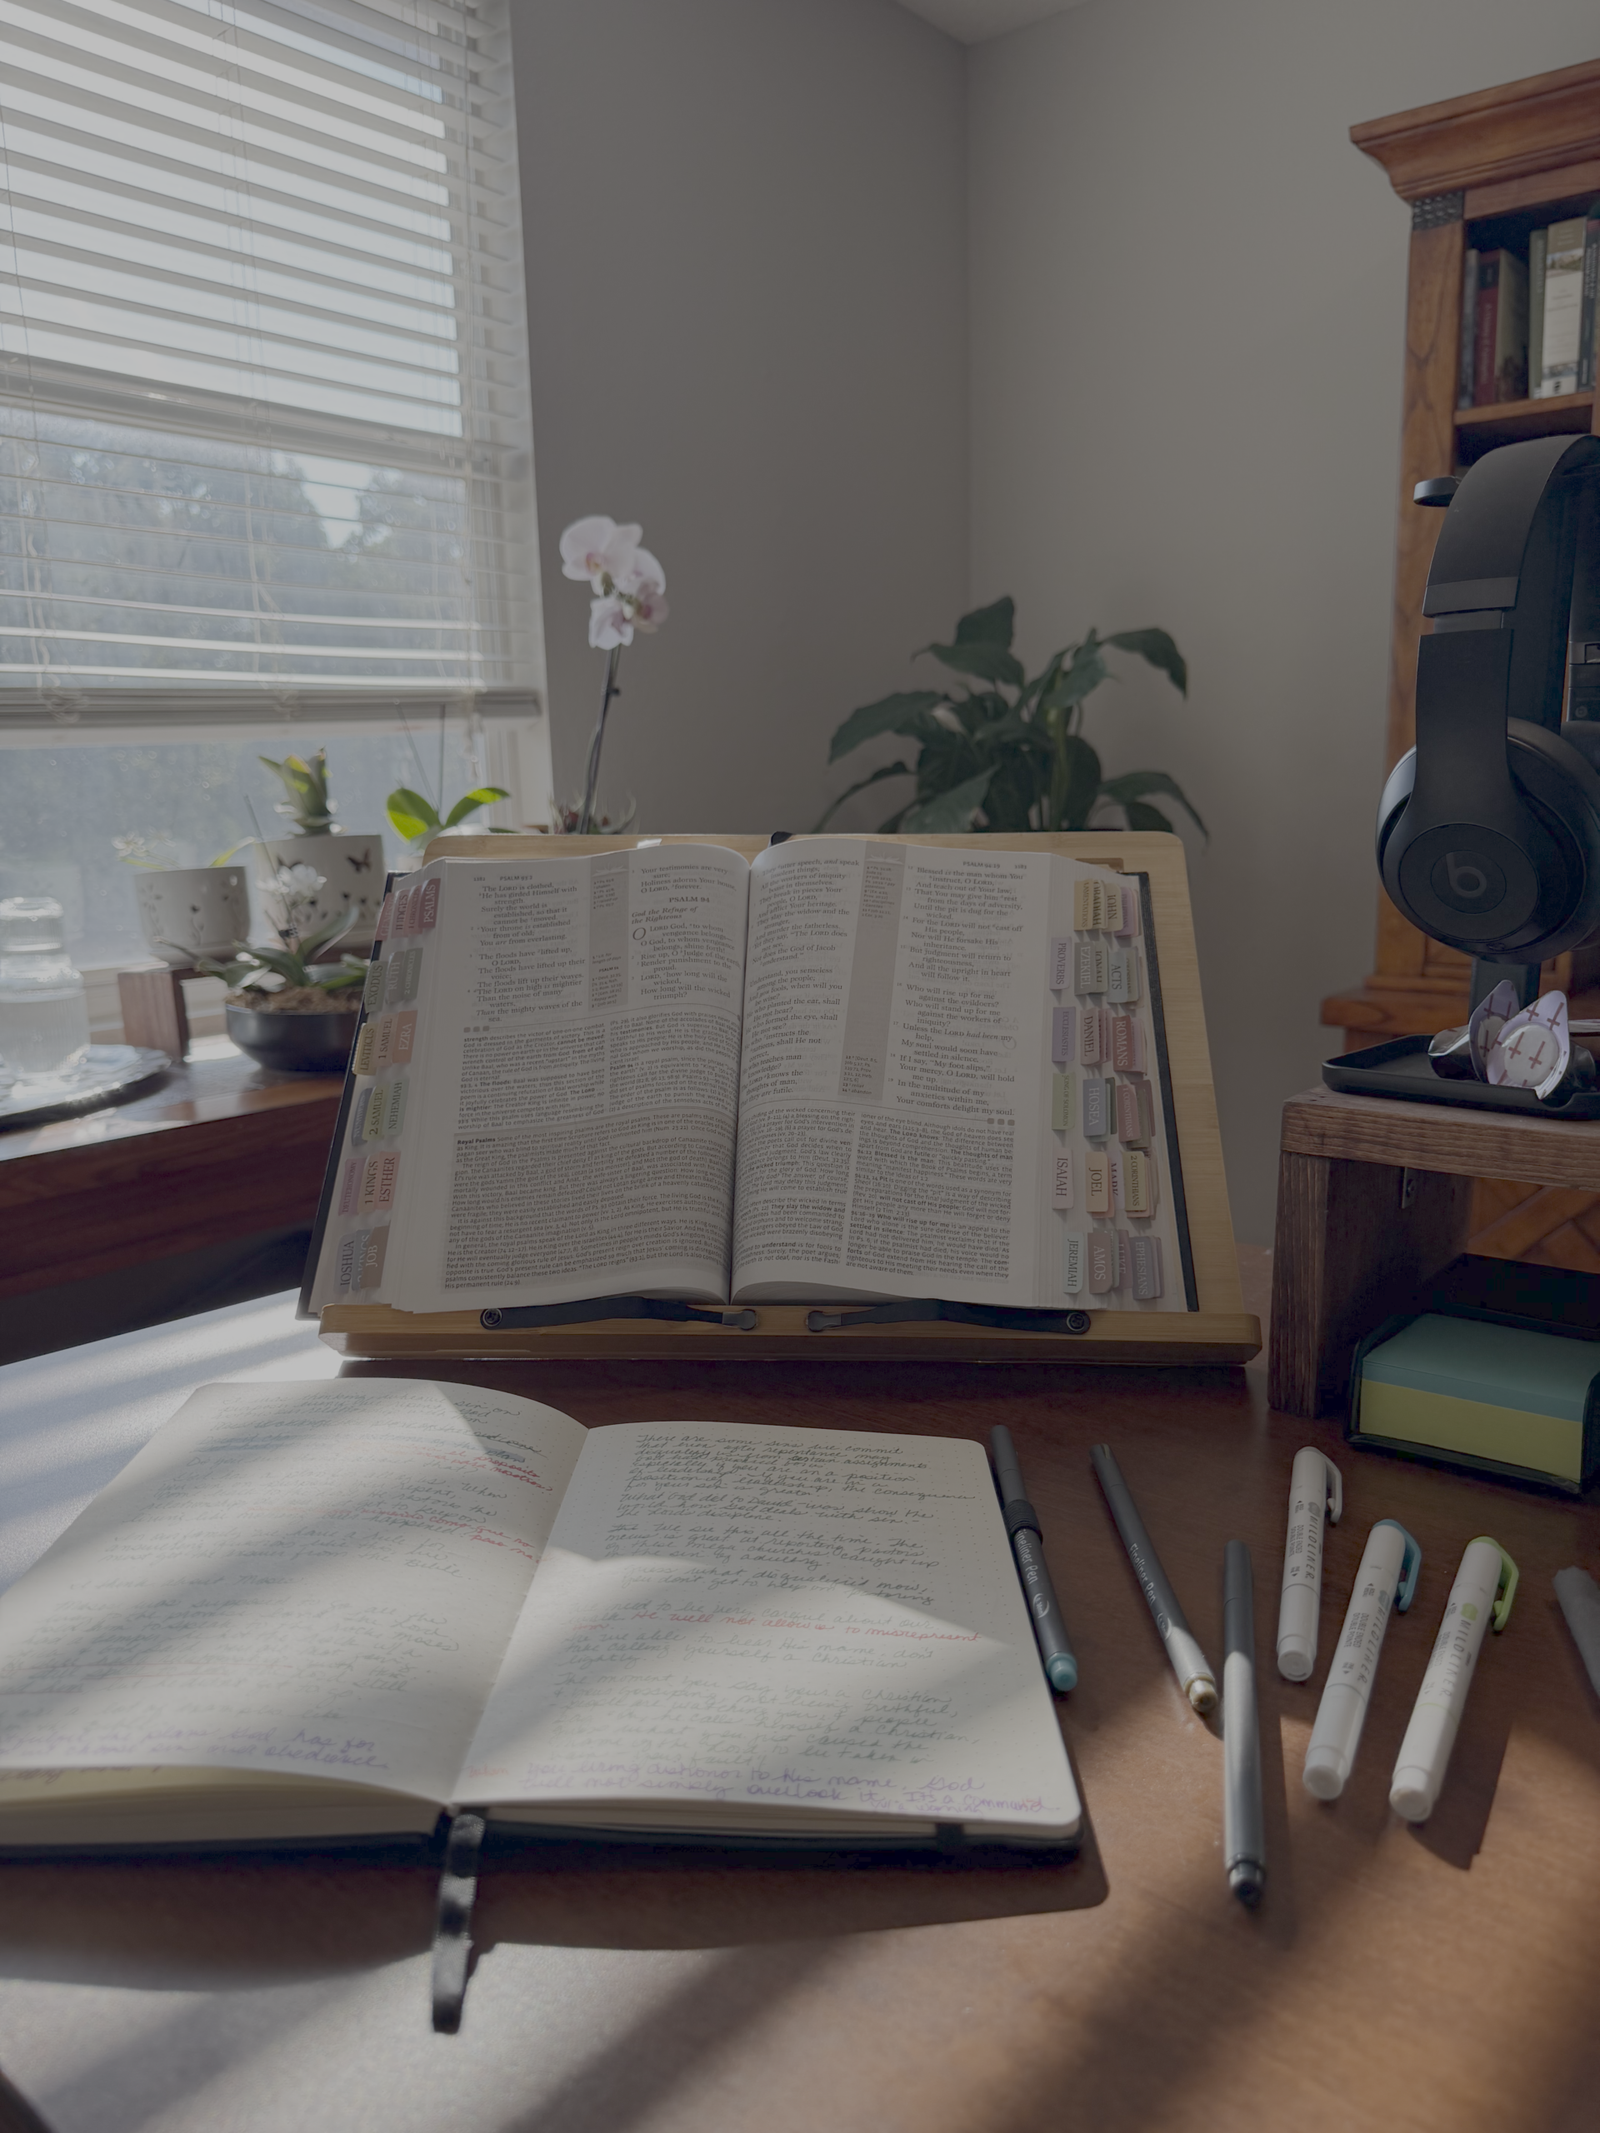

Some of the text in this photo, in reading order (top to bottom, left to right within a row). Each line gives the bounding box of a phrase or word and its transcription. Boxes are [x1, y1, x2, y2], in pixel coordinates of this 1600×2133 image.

[424, 884, 436, 923] PSALMS
[388, 962, 400, 990] RUTH
[1056, 942, 1066, 985] PROVERBS
[1081, 946, 1091, 989] EZEKIEL
[1111, 963, 1122, 990] ACTS
[368, 965, 383, 1006] EXODUS
[361, 1028, 374, 1071] LEVITICUS
[379, 1018, 393, 1053] SAMUEL
[398, 1023, 412, 1050] EZRA
[1084, 1016, 1095, 1057] DANIEL
[1116, 1020, 1128, 1067] ROMANS
[1062, 1074, 1070, 1089] SONG
[369, 1089, 384, 1135] 2 SAMUEL
[388, 1082, 402, 1130] NEHEMIAH
[1089, 1087, 1100, 1126] HOSEA
[1123, 1092, 1134, 1138] CORINTHIANS
[342, 1162, 357, 1213] DEUTERONOMY
[365, 1161, 379, 1198] KINGS
[379, 1157, 395, 1203] ESTHER
[1056, 1158, 1068, 1196] ISAIAH
[1089, 1167, 1102, 1197] JOEL
[1131, 1162, 1140, 1207] CORINTHIANS
[366, 1245, 378, 1268] JOB
[1067, 1239, 1079, 1287] JEREMIAH
[1094, 1245, 1106, 1281] AMOS
[1136, 1241, 1148, 1296] EPHESIANS
[1016, 1529, 1039, 1585] ineliner Pen
[1145, 1581, 1157, 1606] Pen
